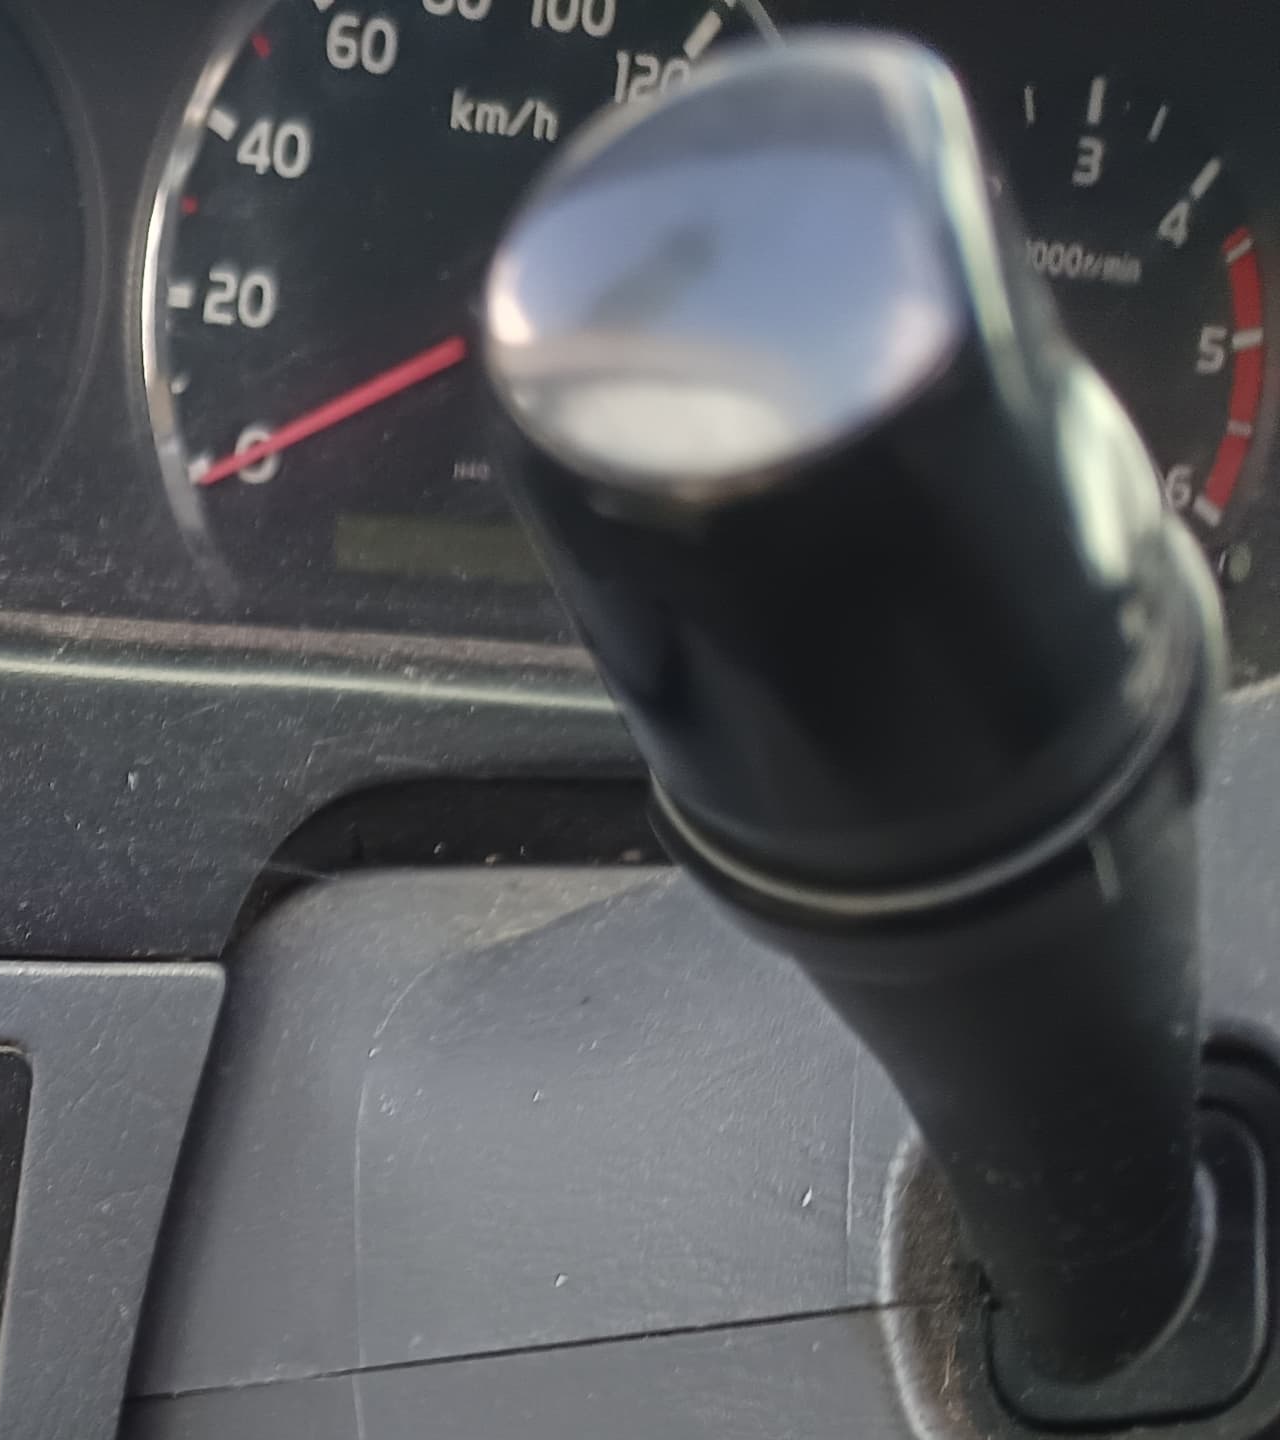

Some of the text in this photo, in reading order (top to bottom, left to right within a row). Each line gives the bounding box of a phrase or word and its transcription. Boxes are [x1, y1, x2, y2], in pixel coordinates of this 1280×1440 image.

[326, 13, 398, 75] 60
[449, 88, 559, 142] km/h
[236, 121, 311, 179] 40
[1071, 136, 1105, 187] 3
[1156, 201, 1191, 249] 4
[201, 271, 277, 329] 20
[1195, 325, 1227, 375] 5
[234, 427, 280, 486] 0
[1164, 463, 1194, 512] 6
